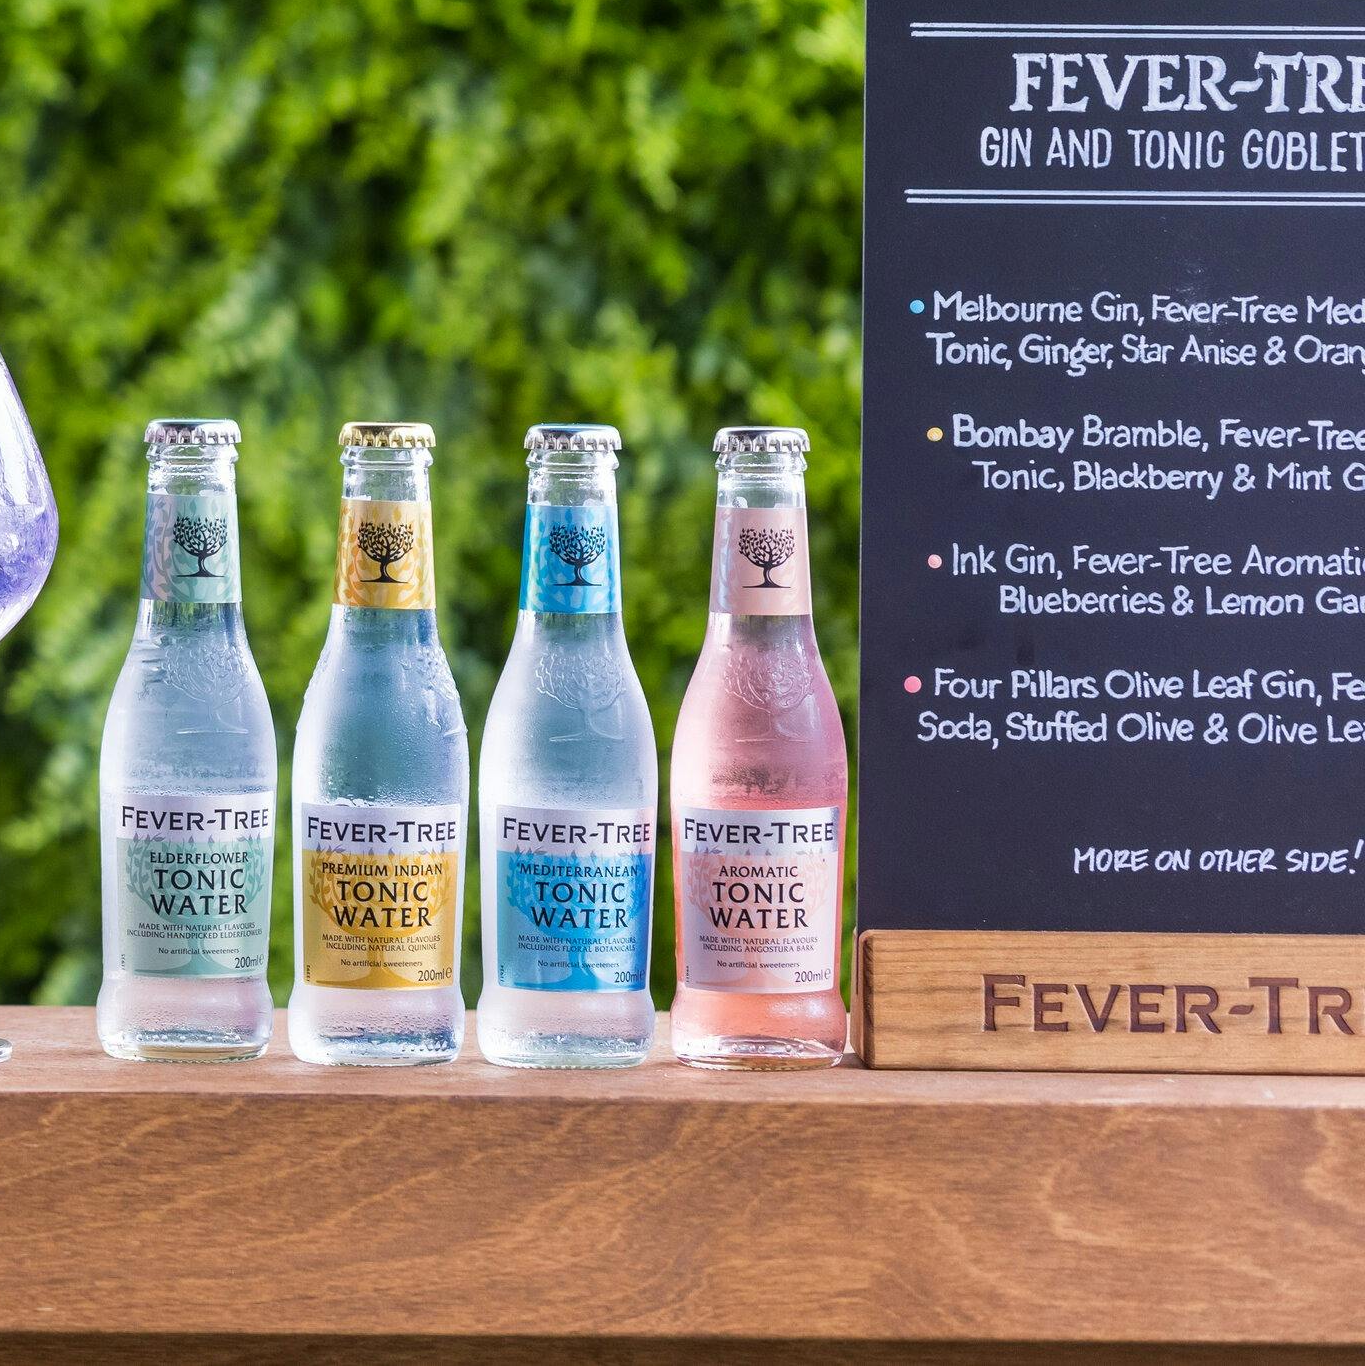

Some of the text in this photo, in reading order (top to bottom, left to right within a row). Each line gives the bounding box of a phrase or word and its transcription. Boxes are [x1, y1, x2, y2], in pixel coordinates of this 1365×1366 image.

[981, 127, 1032, 167] GIN
[1046, 127, 1112, 168] AND
[1127, 129, 1224, 169] TONIC
[934, 291, 1082, 323] Melbourne
[1091, 291, 1144, 326] Gin,
[1152, 294, 1298, 323] Fever-Tree
[926, 332, 1365, 377] Tonic, Ginger, Star Anise & Oran
[953, 413, 1074, 453] Bombay
[1083, 414, 1208, 452] Bramble,
[972, 460, 1331, 500] Tonic, Blackberry & Mint
[953, 543, 1365, 580] Ink Gin, Fever-Tree Aromati
[1000, 585, 1165, 614] Blueberries
[1172, 585, 1193, 616] &
[1206, 586, 1304, 616] Lemon
[935, 668, 1002, 699] Four
[1011, 669, 1099, 699] Pillars
[1105, 670, 1184, 699] Olive
[1193, 669, 1257, 699] Leaf
[1261, 669, 1322, 707] Gin,
[918, 711, 998, 749] Soda,
[1006, 710, 1107, 742] Stuffed
[1117, 712, 1194, 742] Olive
[1203, 713, 1228, 744] &
[1238, 713, 1317, 744] Olive
[122, 806, 268, 831] FEVER-TREE
[308, 817, 456, 843] FEVER-TREE
[504, 817, 650, 843] FEVER-TREE
[685, 818, 833, 844] FEVER-TREE
[150, 852, 248, 864] ELDERFLOWER
[1074, 839, 1364, 874] MORE ON OTHER SIDE!
[154, 868, 244, 889] TONIC
[322, 863, 442, 875] PREMIUM INDIAN
[520, 865, 637, 878] MEDITERRANEAN
[719, 865, 798, 877] AROMATIC
[337, 881, 427, 902] TONIC
[536, 882, 625, 903] TONIC
[712, 882, 804, 902] TONIC
[150, 894, 247, 915] WATER
[332, 906, 432, 927] WATER
[531, 907, 628, 929] WATER
[709, 907, 808, 928] WATER
[322, 934, 343, 942] MADE
[407, 935, 440, 943] FLAVOURS
[326, 943, 366, 951] INCLUDING
[409, 943, 437, 952] QUININE
